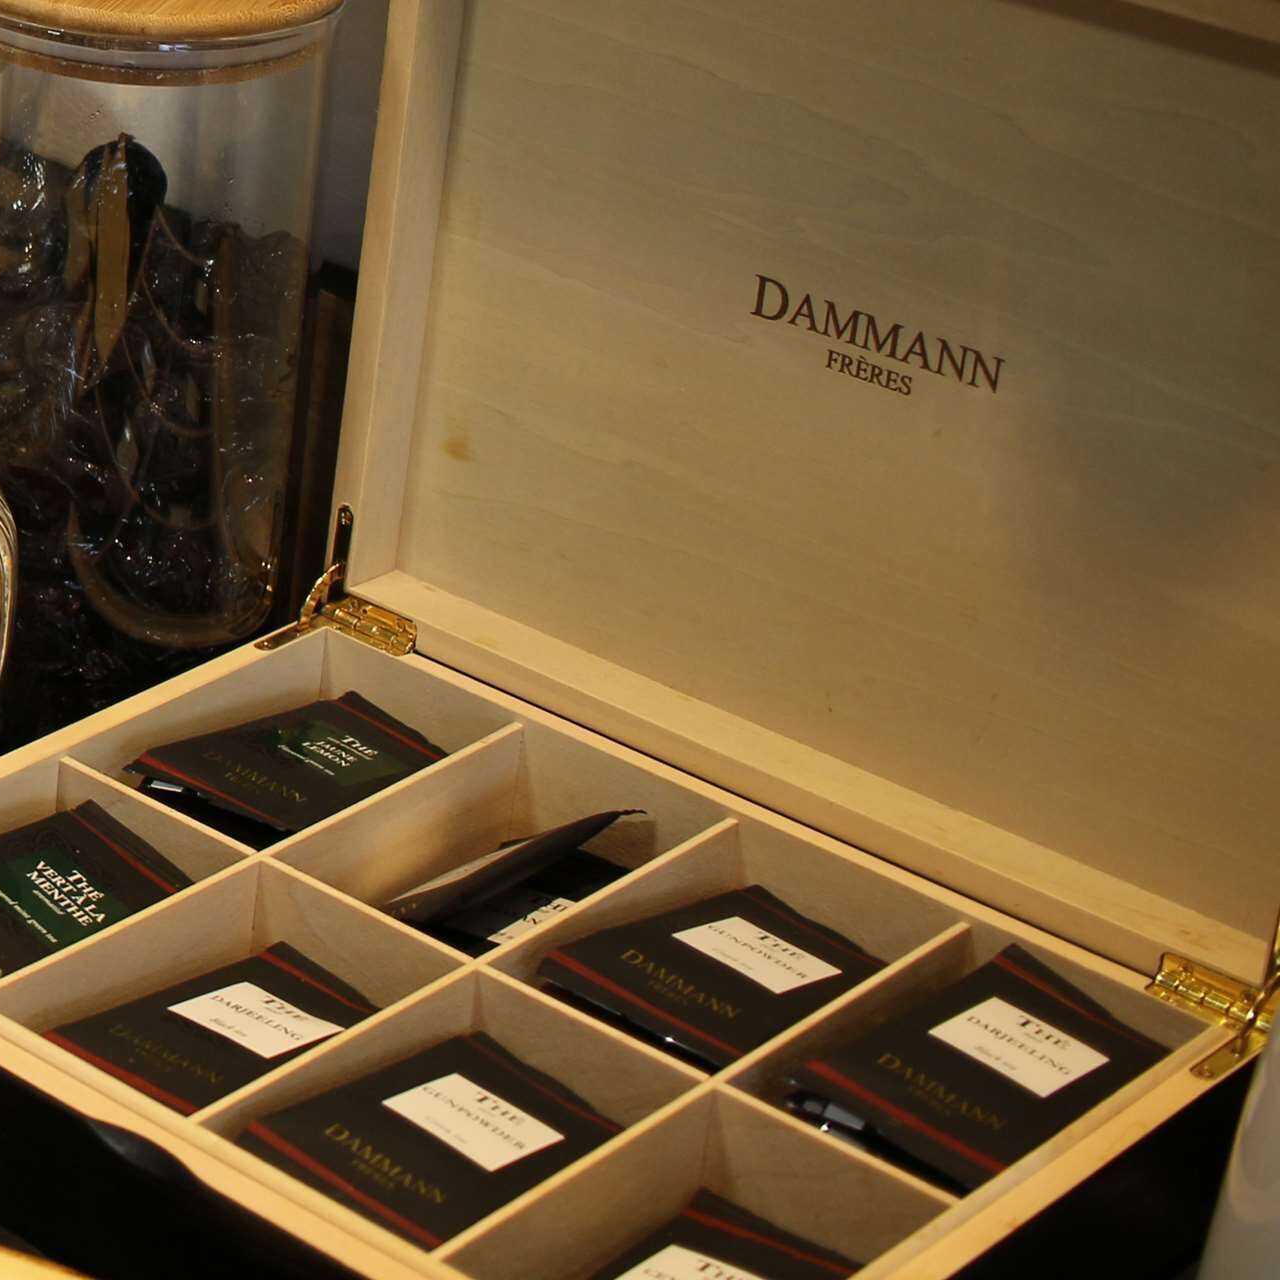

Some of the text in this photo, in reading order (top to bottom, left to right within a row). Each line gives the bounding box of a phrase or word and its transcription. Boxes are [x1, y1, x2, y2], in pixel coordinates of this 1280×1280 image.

[749, 273, 1006, 394] DAMMANN
[824, 348, 914, 397] FRÈRES
[26, 870, 94, 927] MENTHE
[36, 860, 79, 893] VERT
[83, 903, 106, 924] LA
[707, 925, 807, 979] GUNPOWDER
[210, 995, 304, 1041] DARJEELING
[967, 1015, 1072, 1076] DARJEELING
[422, 1086, 525, 1150] GUNPOWDER
[324, 1122, 447, 1204] DAMMANN
